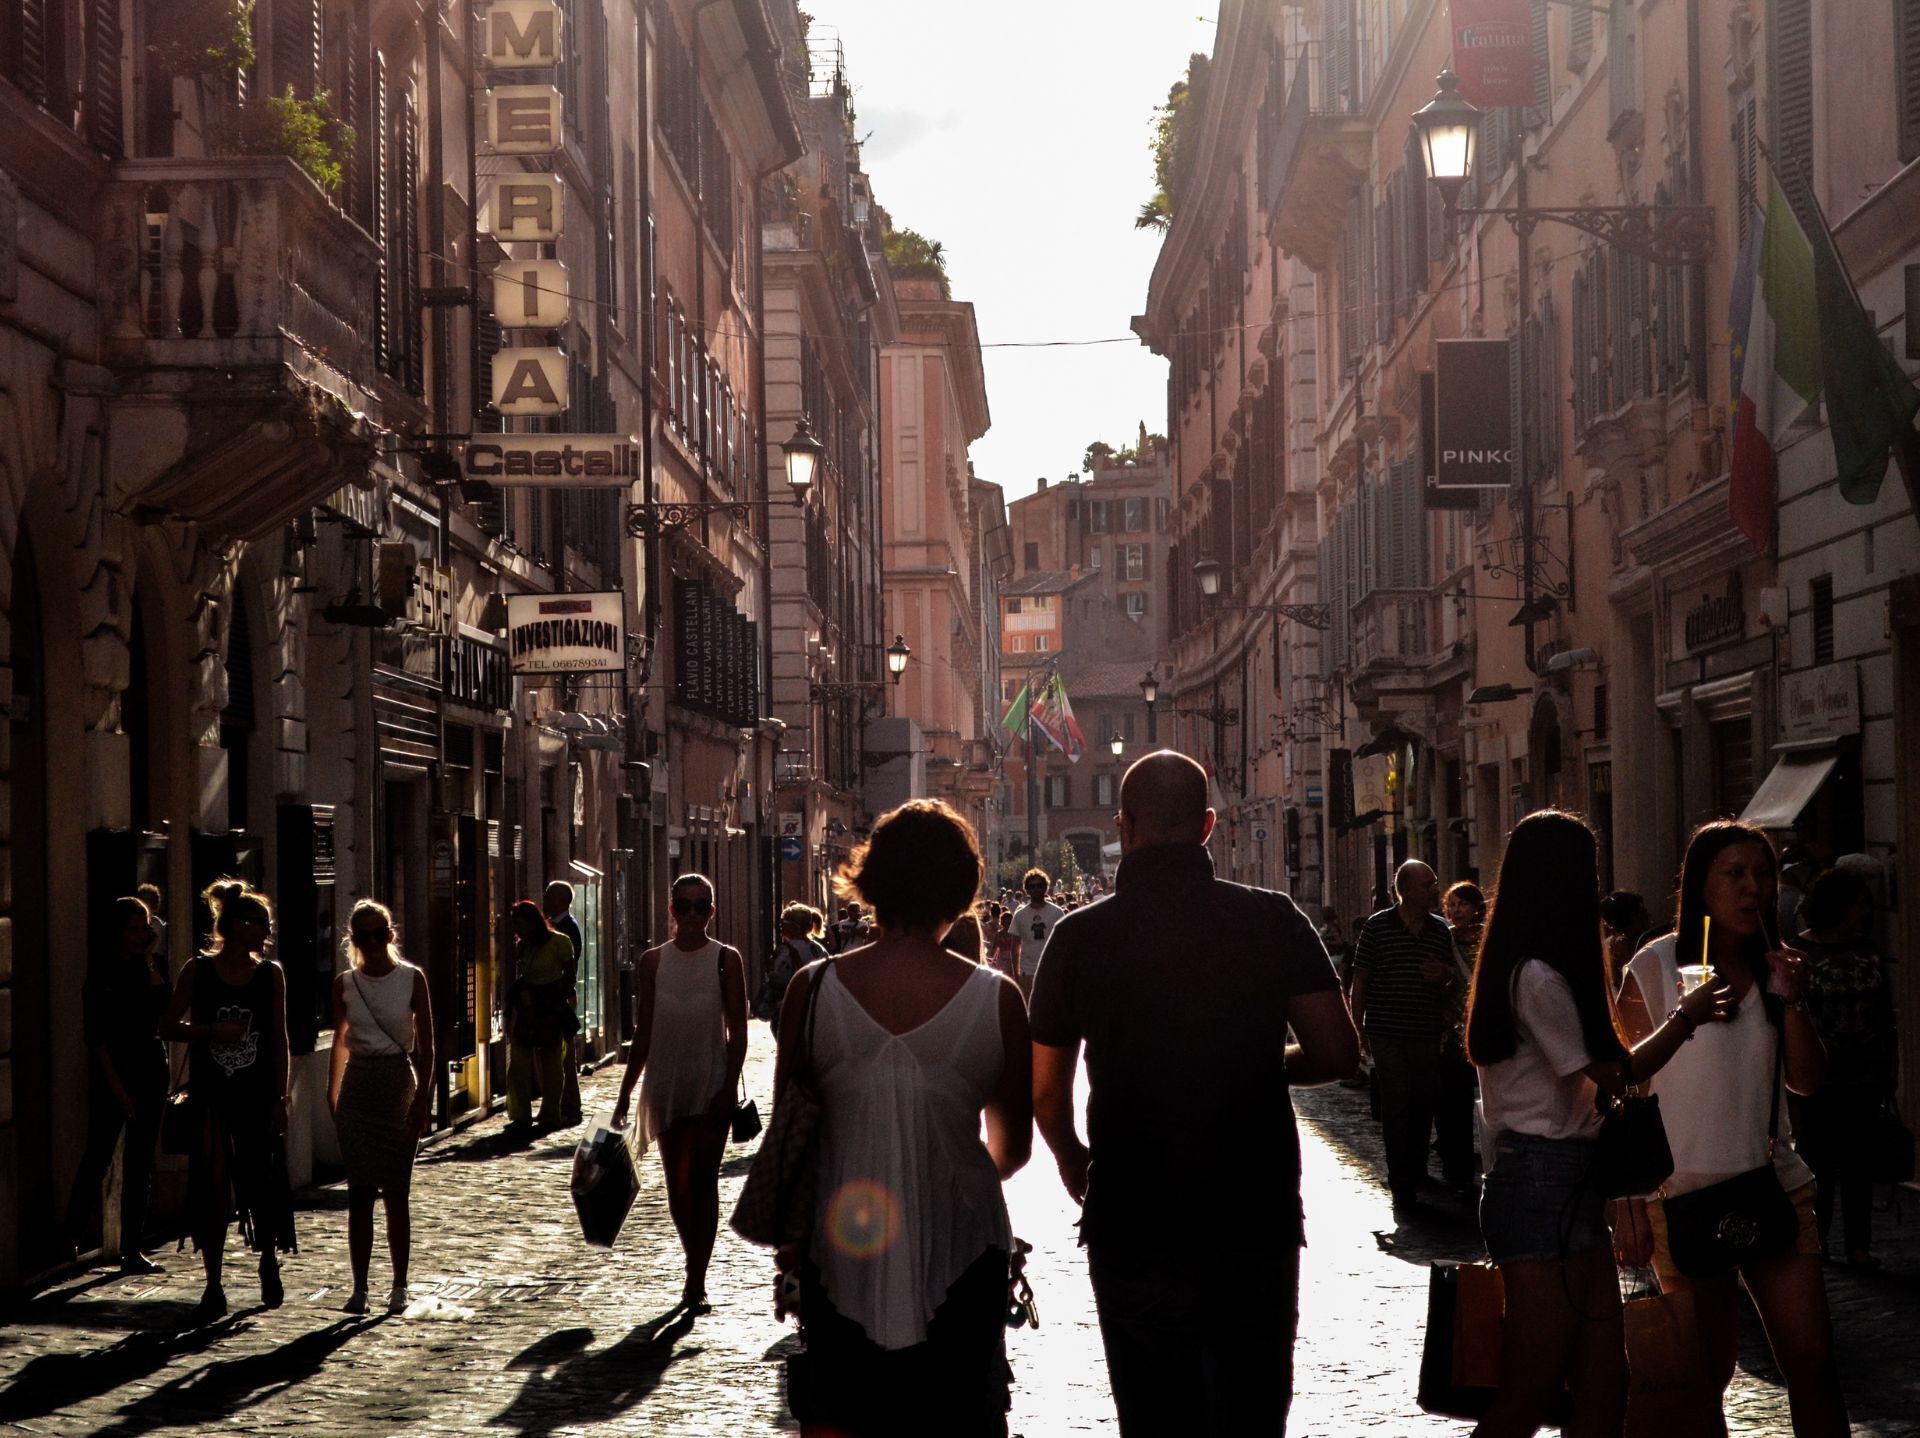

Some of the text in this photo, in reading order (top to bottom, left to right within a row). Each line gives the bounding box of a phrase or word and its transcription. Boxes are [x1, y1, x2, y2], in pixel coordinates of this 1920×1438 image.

[491, 11, 559, 405] MERIA
[465, 444, 639, 476] Castelli
[511, 618, 618, 658] INVESTIGAZIONI
[685, 587, 699, 700] FLAVIO CASTELLANI
[527, 659, 608, 670] TEL. 066789341
